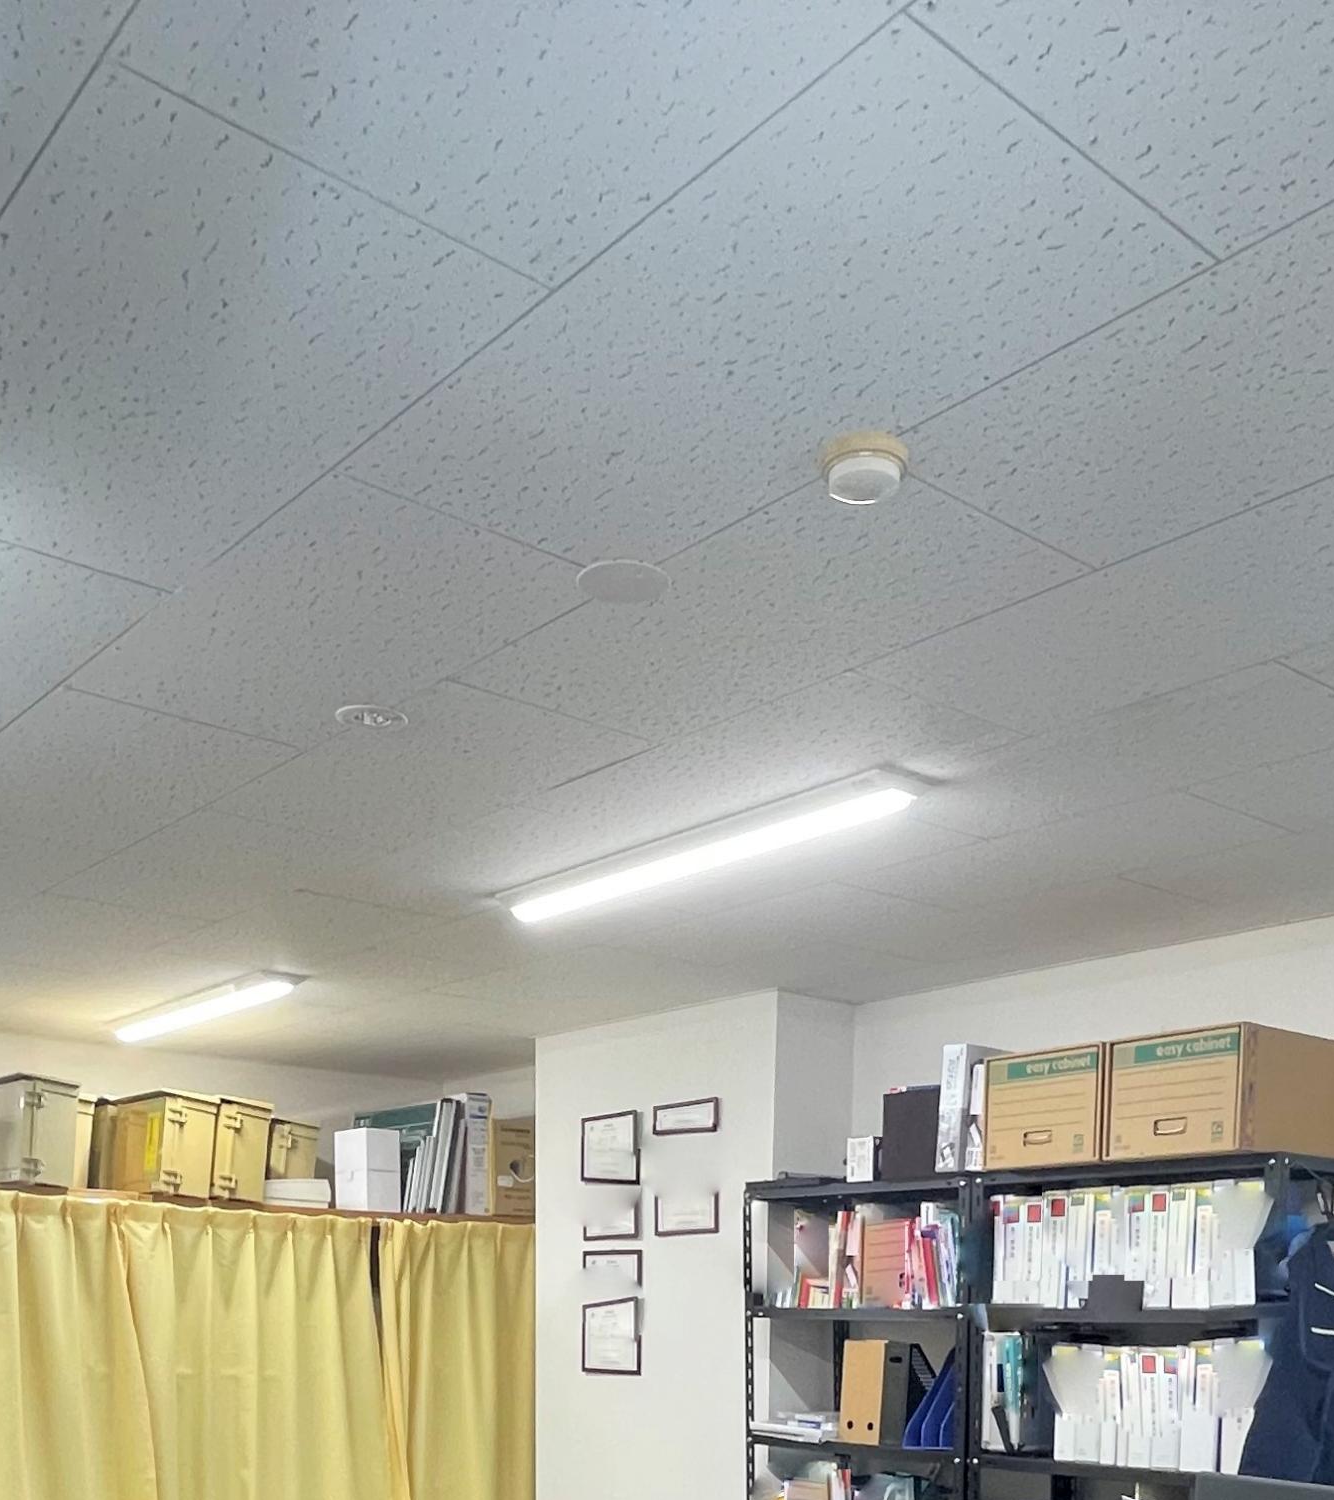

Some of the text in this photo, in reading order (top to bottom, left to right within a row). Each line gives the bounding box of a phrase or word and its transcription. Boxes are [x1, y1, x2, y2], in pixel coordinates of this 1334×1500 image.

[1156, 1035, 1232, 1058] easy cabinet
[1025, 1055, 1091, 1076] easy cabinet
